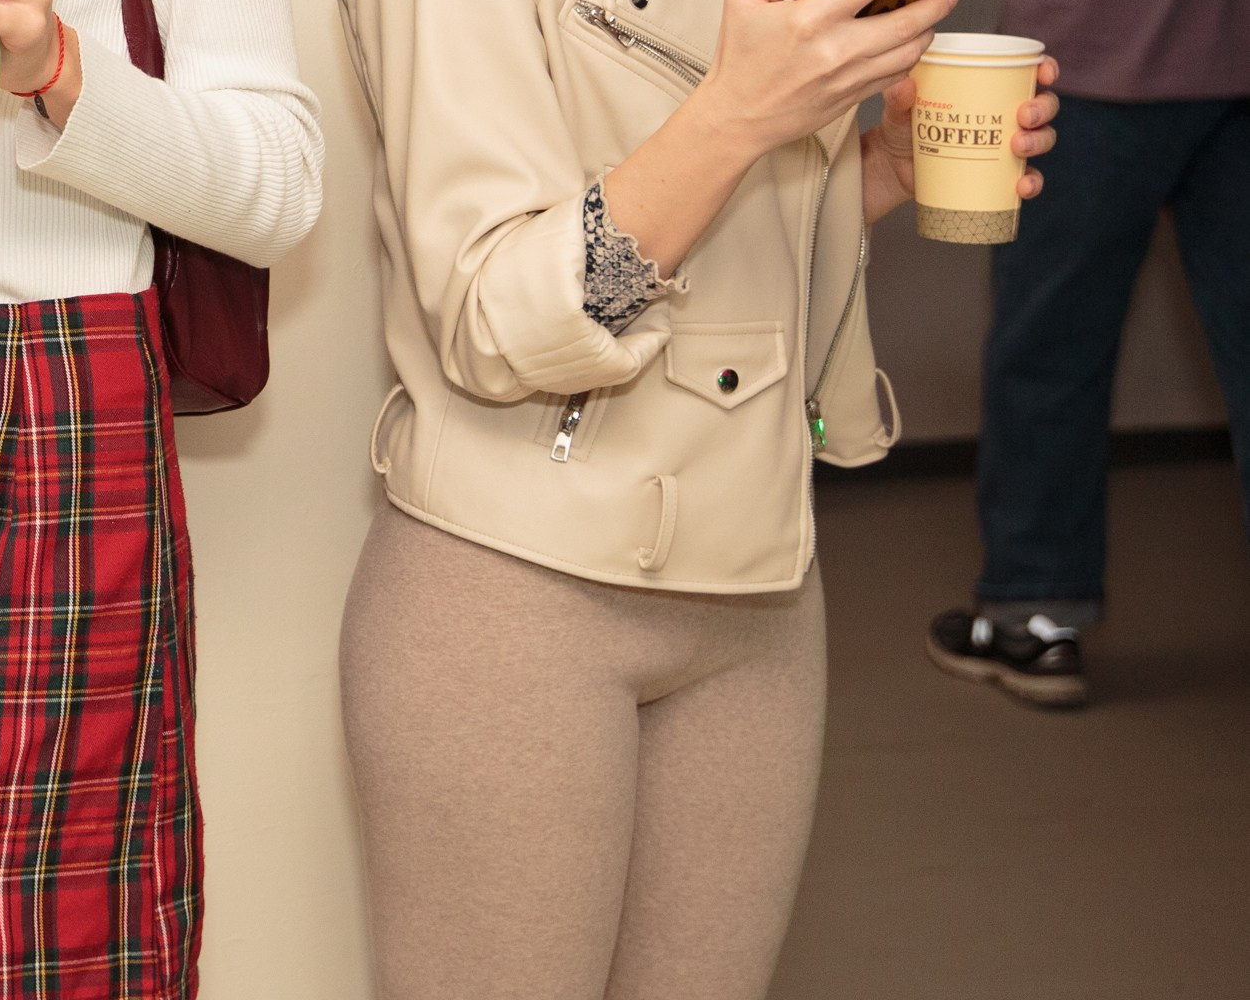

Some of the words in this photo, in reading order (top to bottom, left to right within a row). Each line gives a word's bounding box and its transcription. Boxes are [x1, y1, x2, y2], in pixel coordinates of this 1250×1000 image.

[916, 97, 953, 110] Espresso
[917, 109, 1003, 125] PREMIUM
[917, 123, 1003, 145] COFFEE
